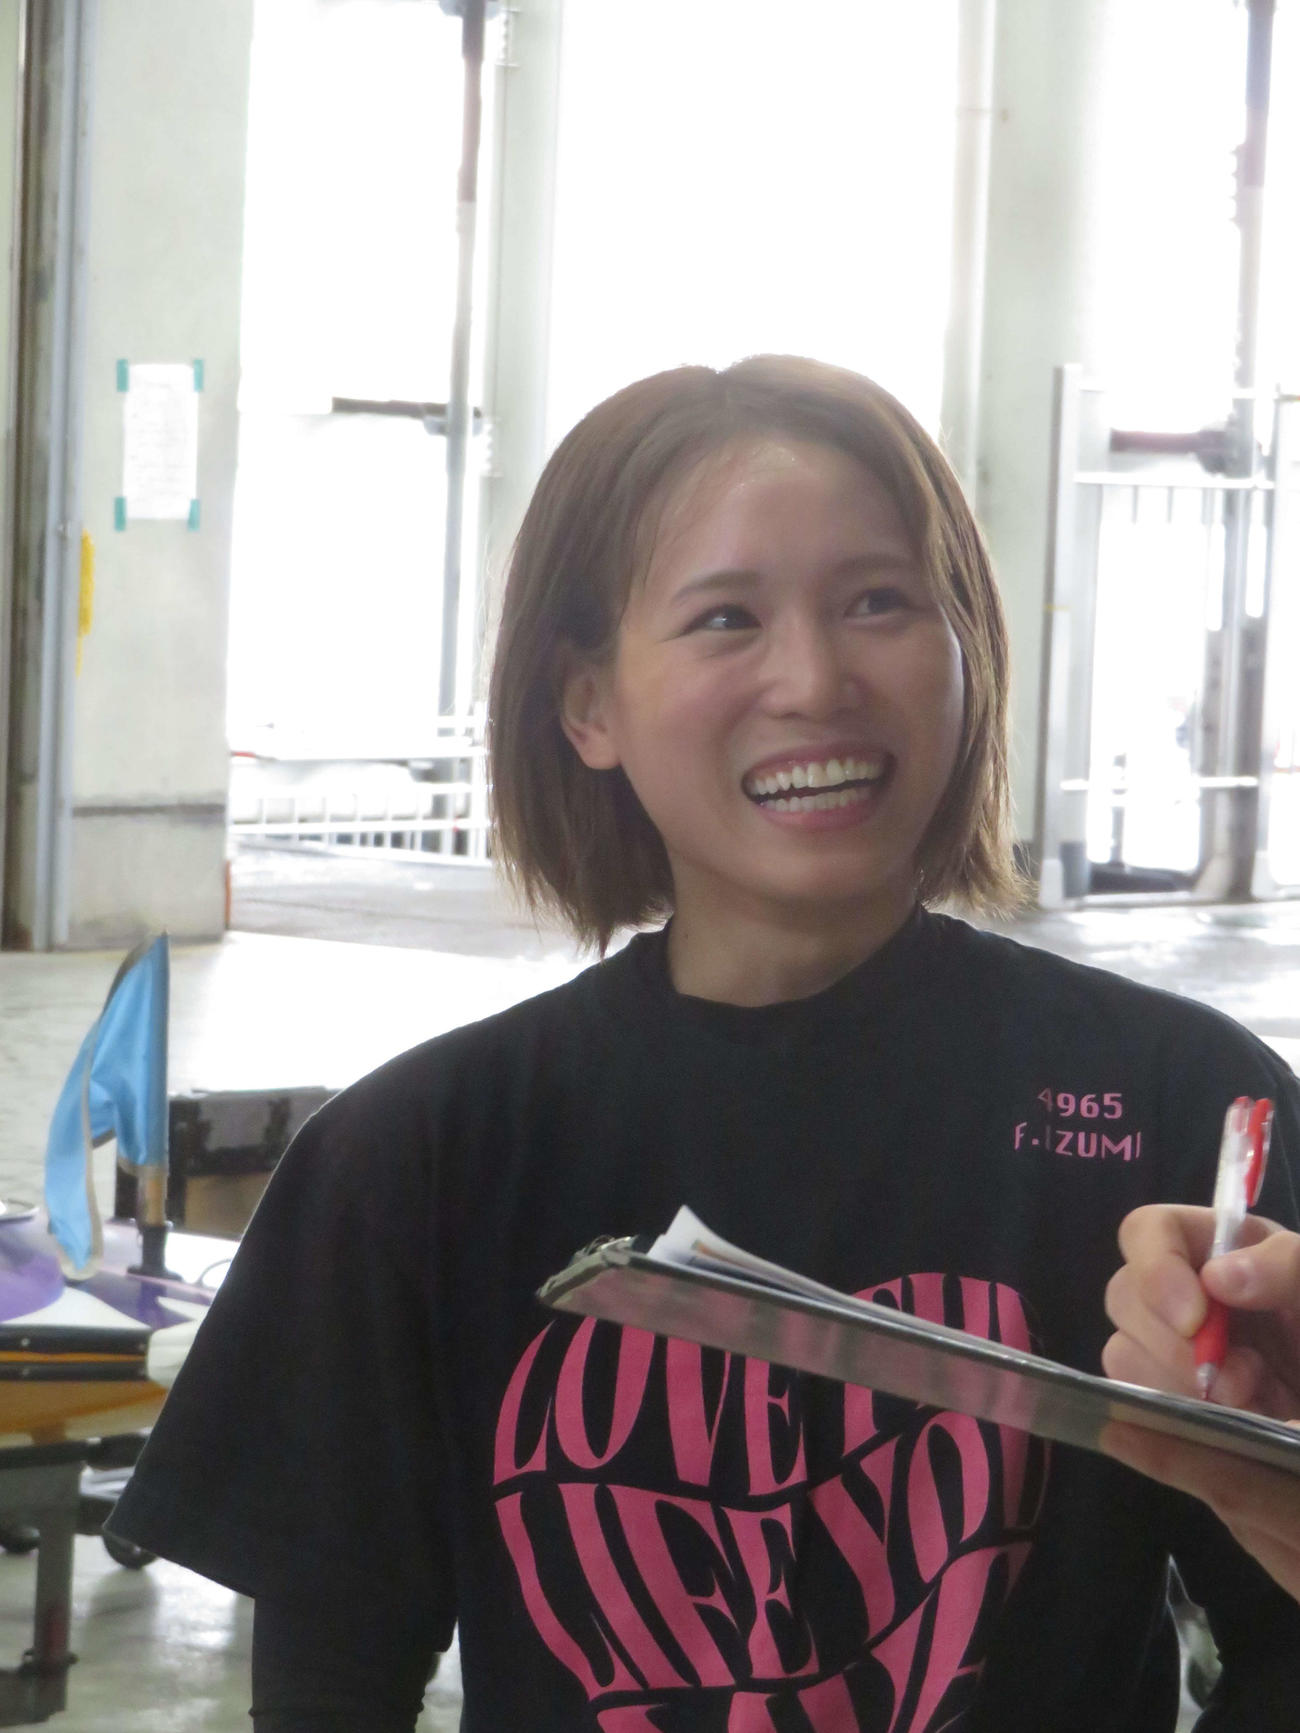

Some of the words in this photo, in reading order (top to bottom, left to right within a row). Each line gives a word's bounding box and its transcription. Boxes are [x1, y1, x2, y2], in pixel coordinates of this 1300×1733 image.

[1037, 1087, 1123, 1119] 4965
[493, 1316, 808, 1496] LOVE
[494, 1483, 820, 1701] LIFE
